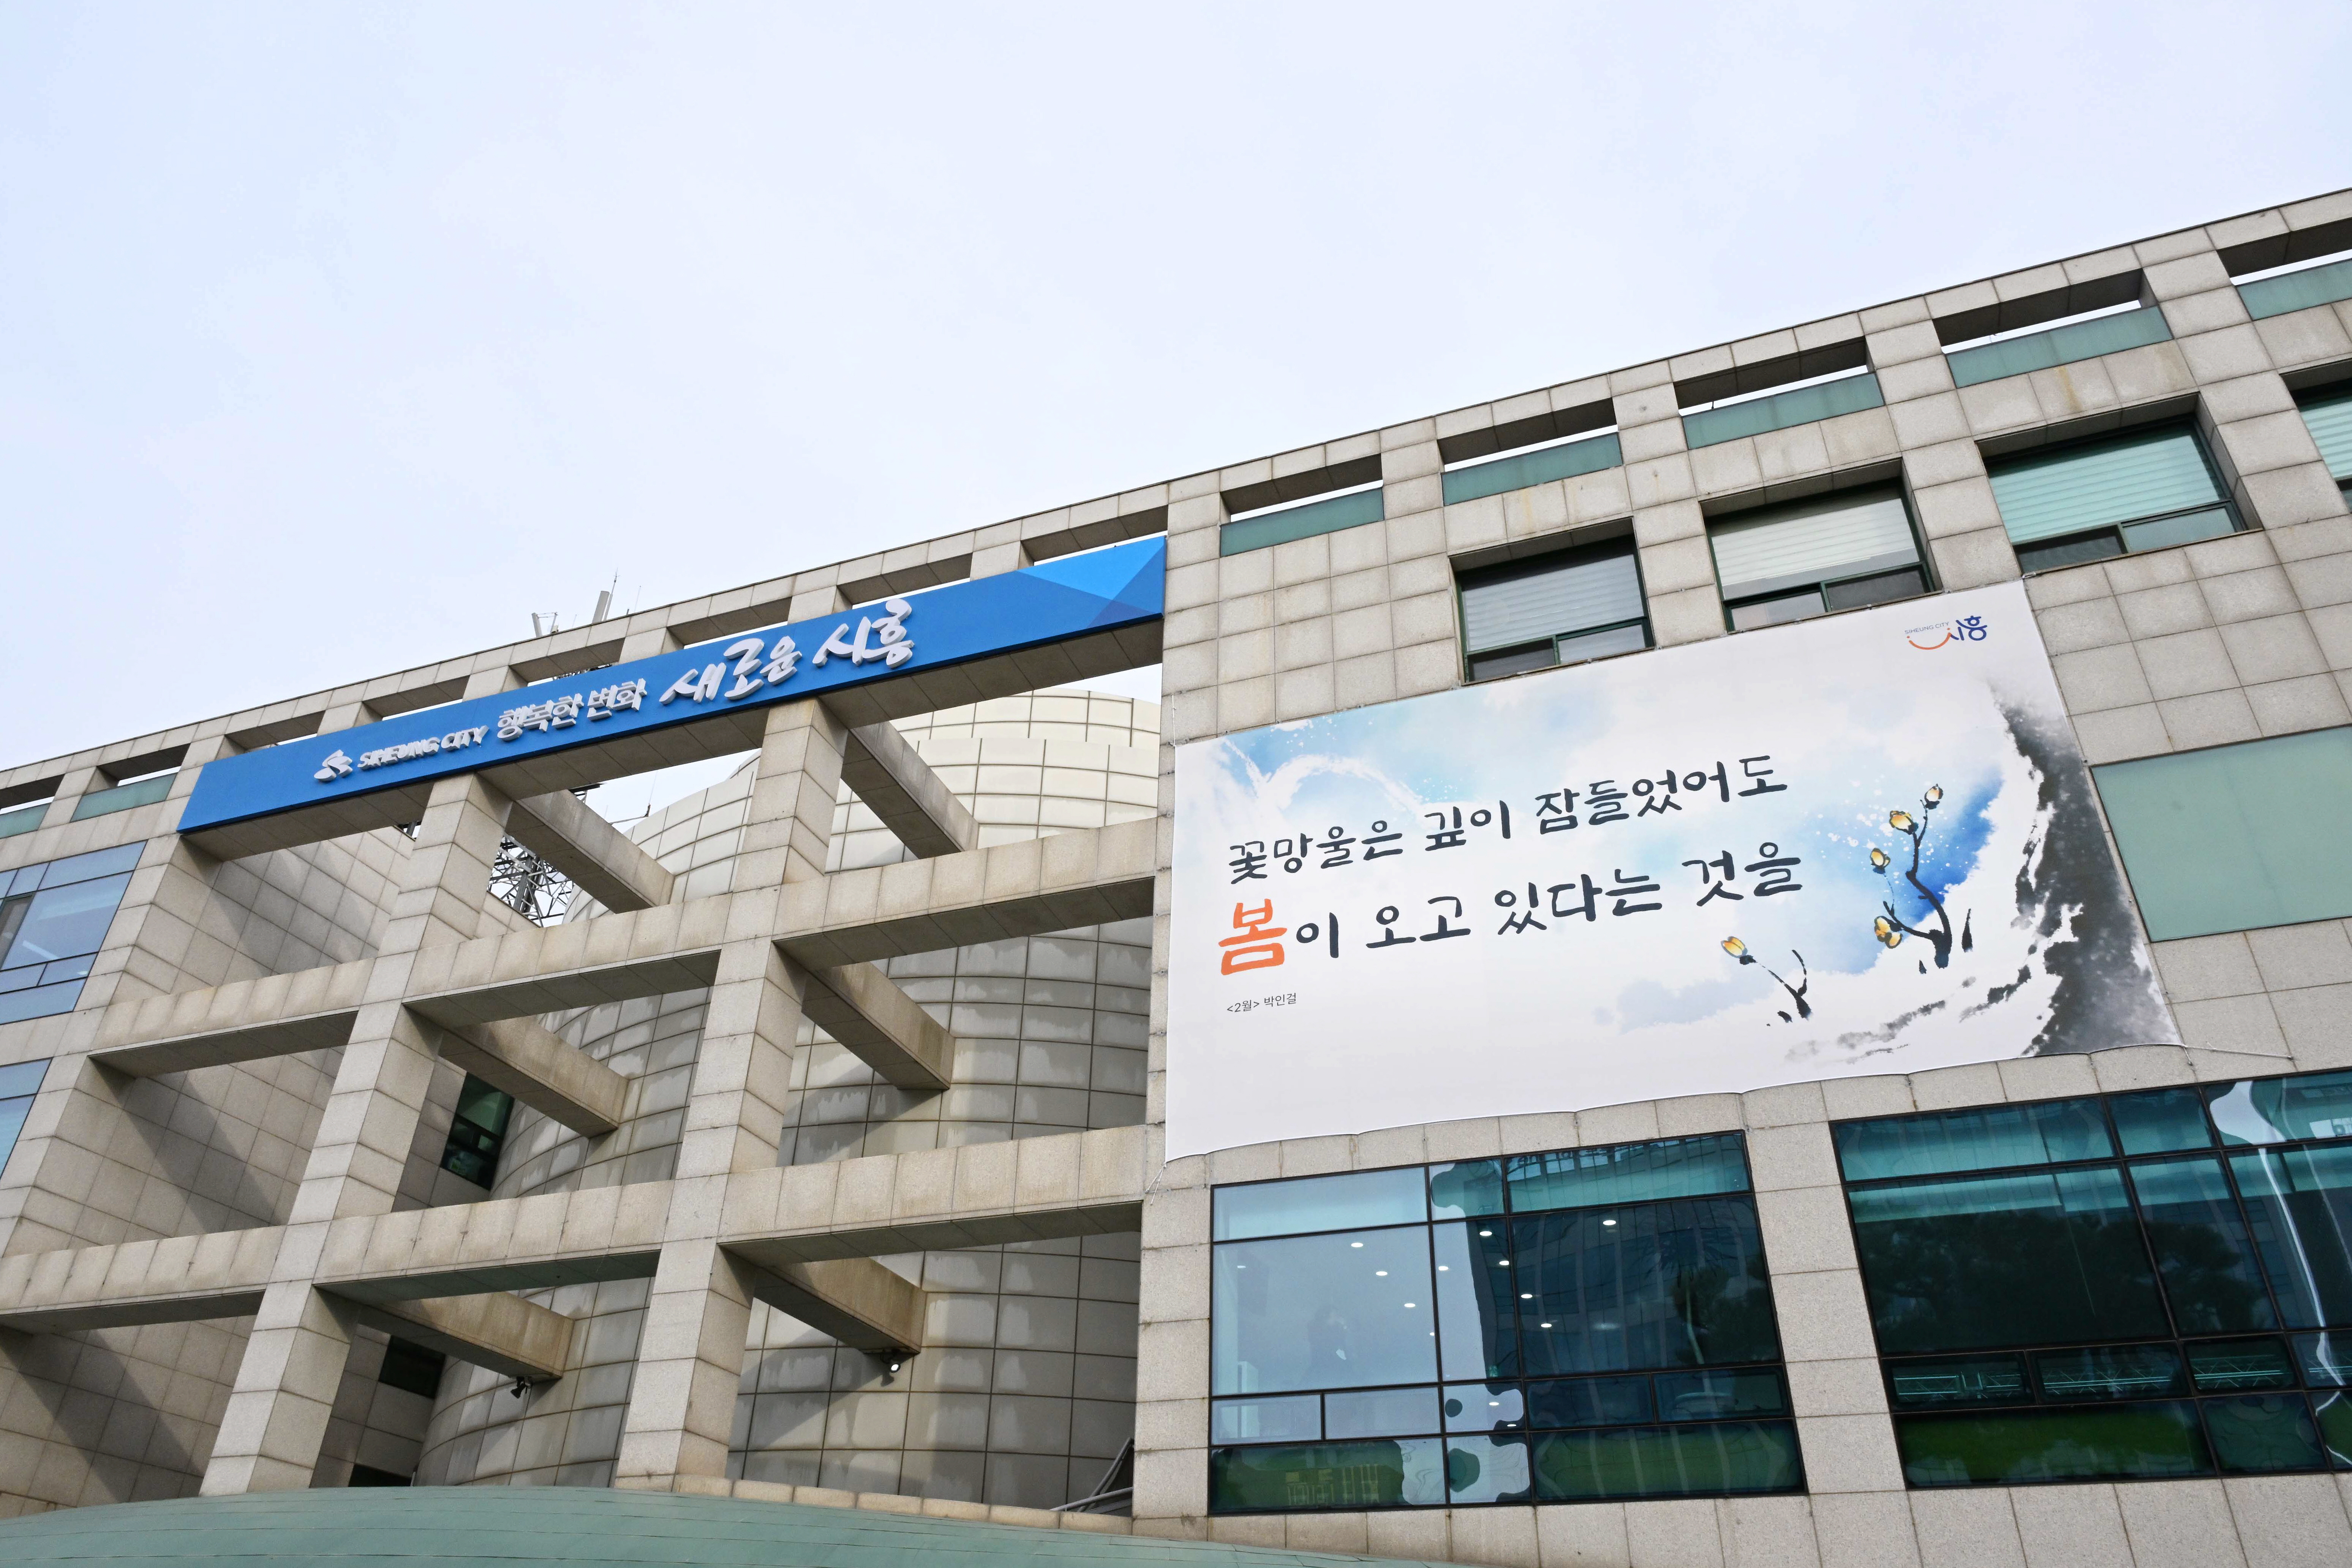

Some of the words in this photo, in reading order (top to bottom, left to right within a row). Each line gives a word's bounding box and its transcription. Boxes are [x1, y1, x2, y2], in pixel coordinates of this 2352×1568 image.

[1904, 625, 1934, 634] SIHEUNG
[1933, 615, 1988, 648] 시흥
[497, 693, 584, 741] 행복한
[587, 678, 647, 721] 변화
[659, 635, 802, 705] 새로운
[812, 598, 915, 669] 시흥
[357, 737, 441, 770] SIHEUNG
[441, 725, 490, 751] CITY
[1229, 820, 1403, 884] 꽃망울은
[1424, 800, 1511, 851] 깊이
[1535, 755, 1788, 835] 잠들었어도
[1219, 898, 1339, 976] 봄이
[1366, 896, 1471, 948] 오고
[1495, 869, 1662, 936] 있다는
[1682, 842, 1803, 907] 것을
[1227, 999, 1260, 1012] <2월>
[1264, 993, 1296, 1007] 박인걸
